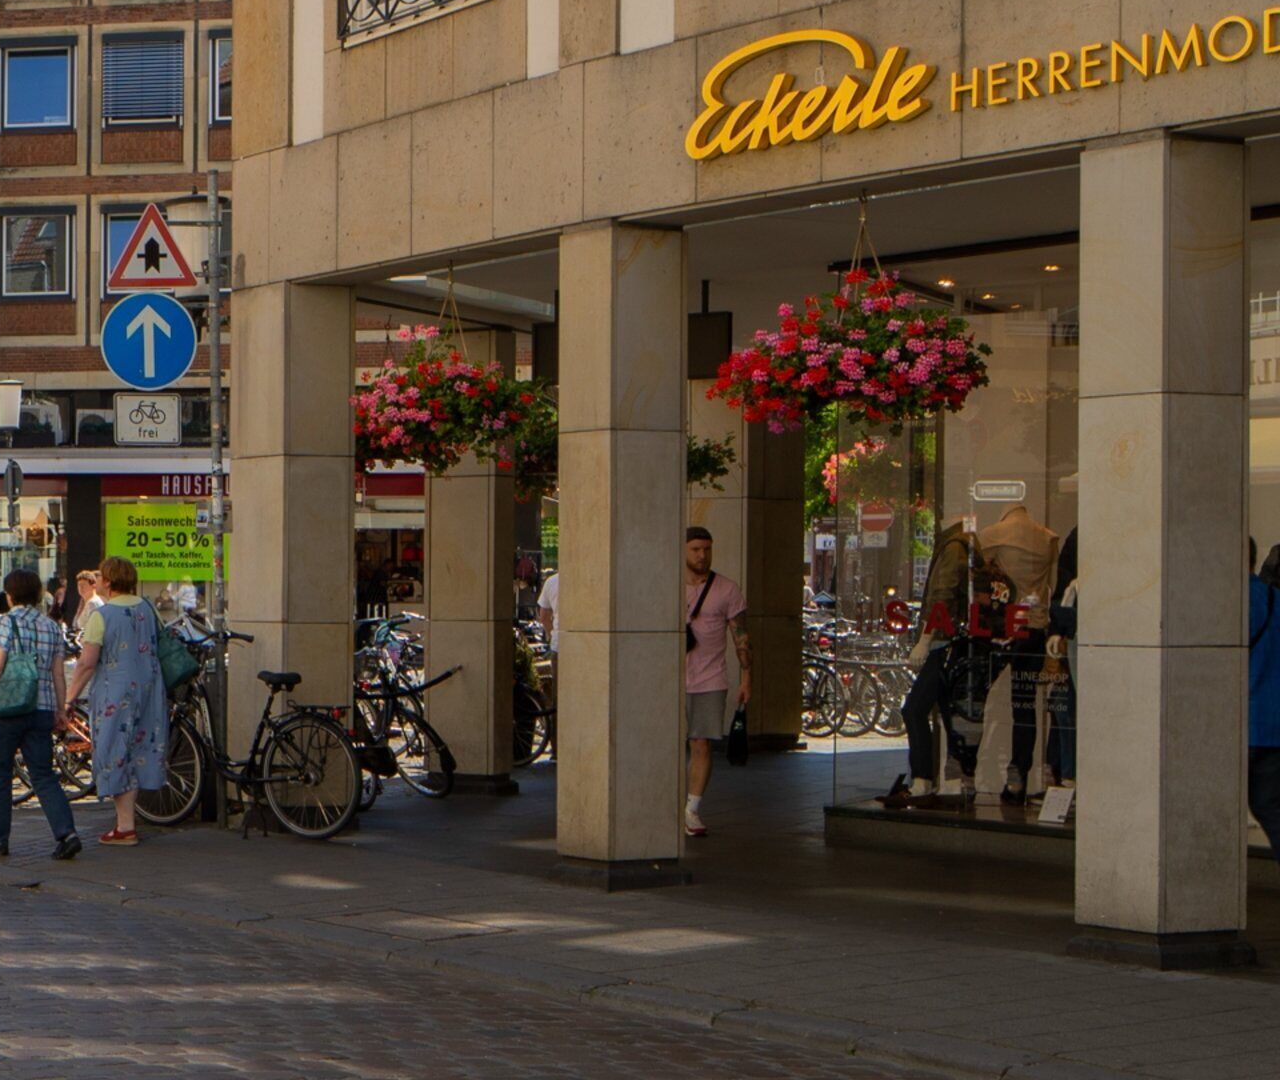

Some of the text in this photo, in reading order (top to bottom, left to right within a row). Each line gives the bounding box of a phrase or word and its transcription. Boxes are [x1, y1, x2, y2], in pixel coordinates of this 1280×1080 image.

[685, 28, 938, 160] Eckerle
[138, 427, 159, 439] frei
[127, 514, 196, 527] Saisonwech
[886, 600, 1031, 638] SALE
